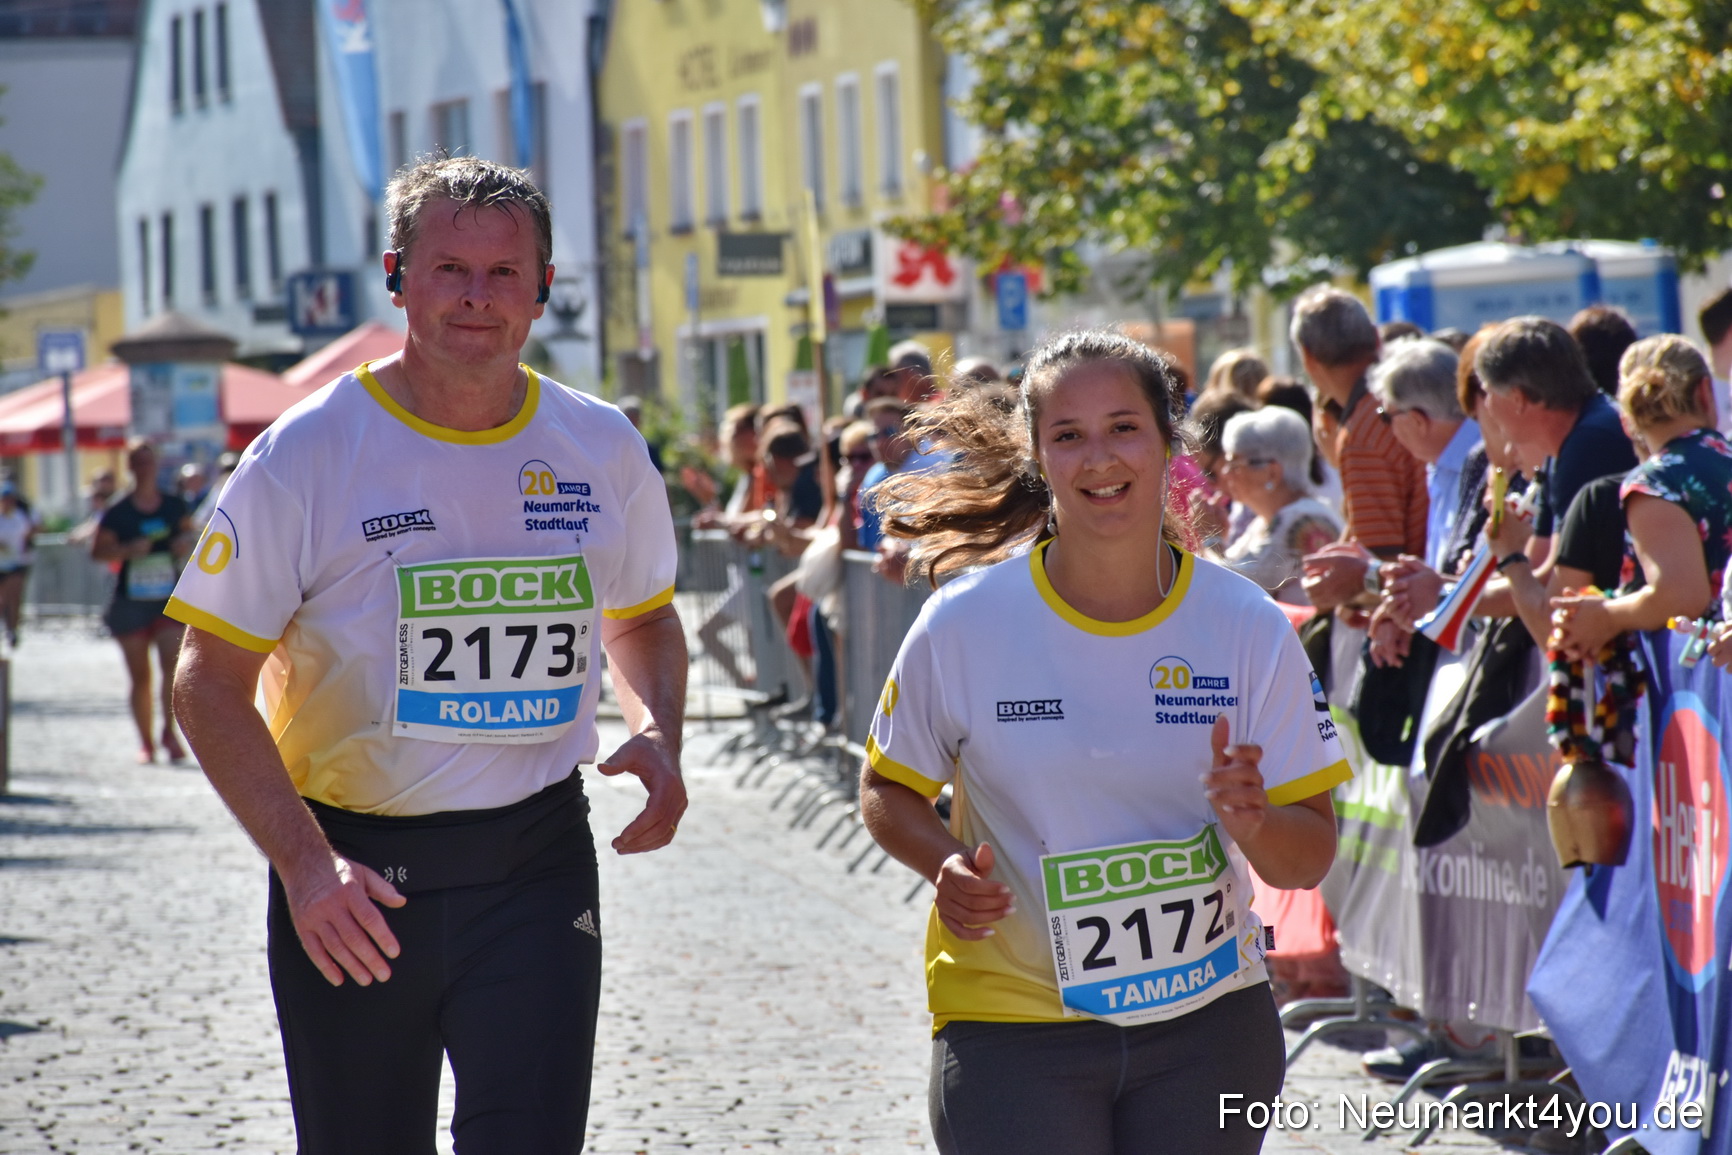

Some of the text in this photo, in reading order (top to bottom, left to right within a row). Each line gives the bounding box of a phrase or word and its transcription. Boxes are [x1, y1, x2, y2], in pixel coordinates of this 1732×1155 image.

[523, 470, 588, 496] 20 JAHRE
[523, 499, 601, 513] Neumarkter
[362, 509, 434, 536] BOCK
[525, 517, 589, 533] Stadtlauf
[414, 564, 583, 611] BOCK
[422, 623, 576, 681] 2173
[1155, 665, 1226, 690] 20 JAHRE
[439, 698, 560, 723] ROLAND
[997, 699, 1064, 716] BOCK
[1156, 711, 1222, 724] Stadtlau
[1060, 834, 1220, 901] BOCK
[1076, 889, 1224, 971] 2172
[1102, 961, 1216, 1009] TAMARA
